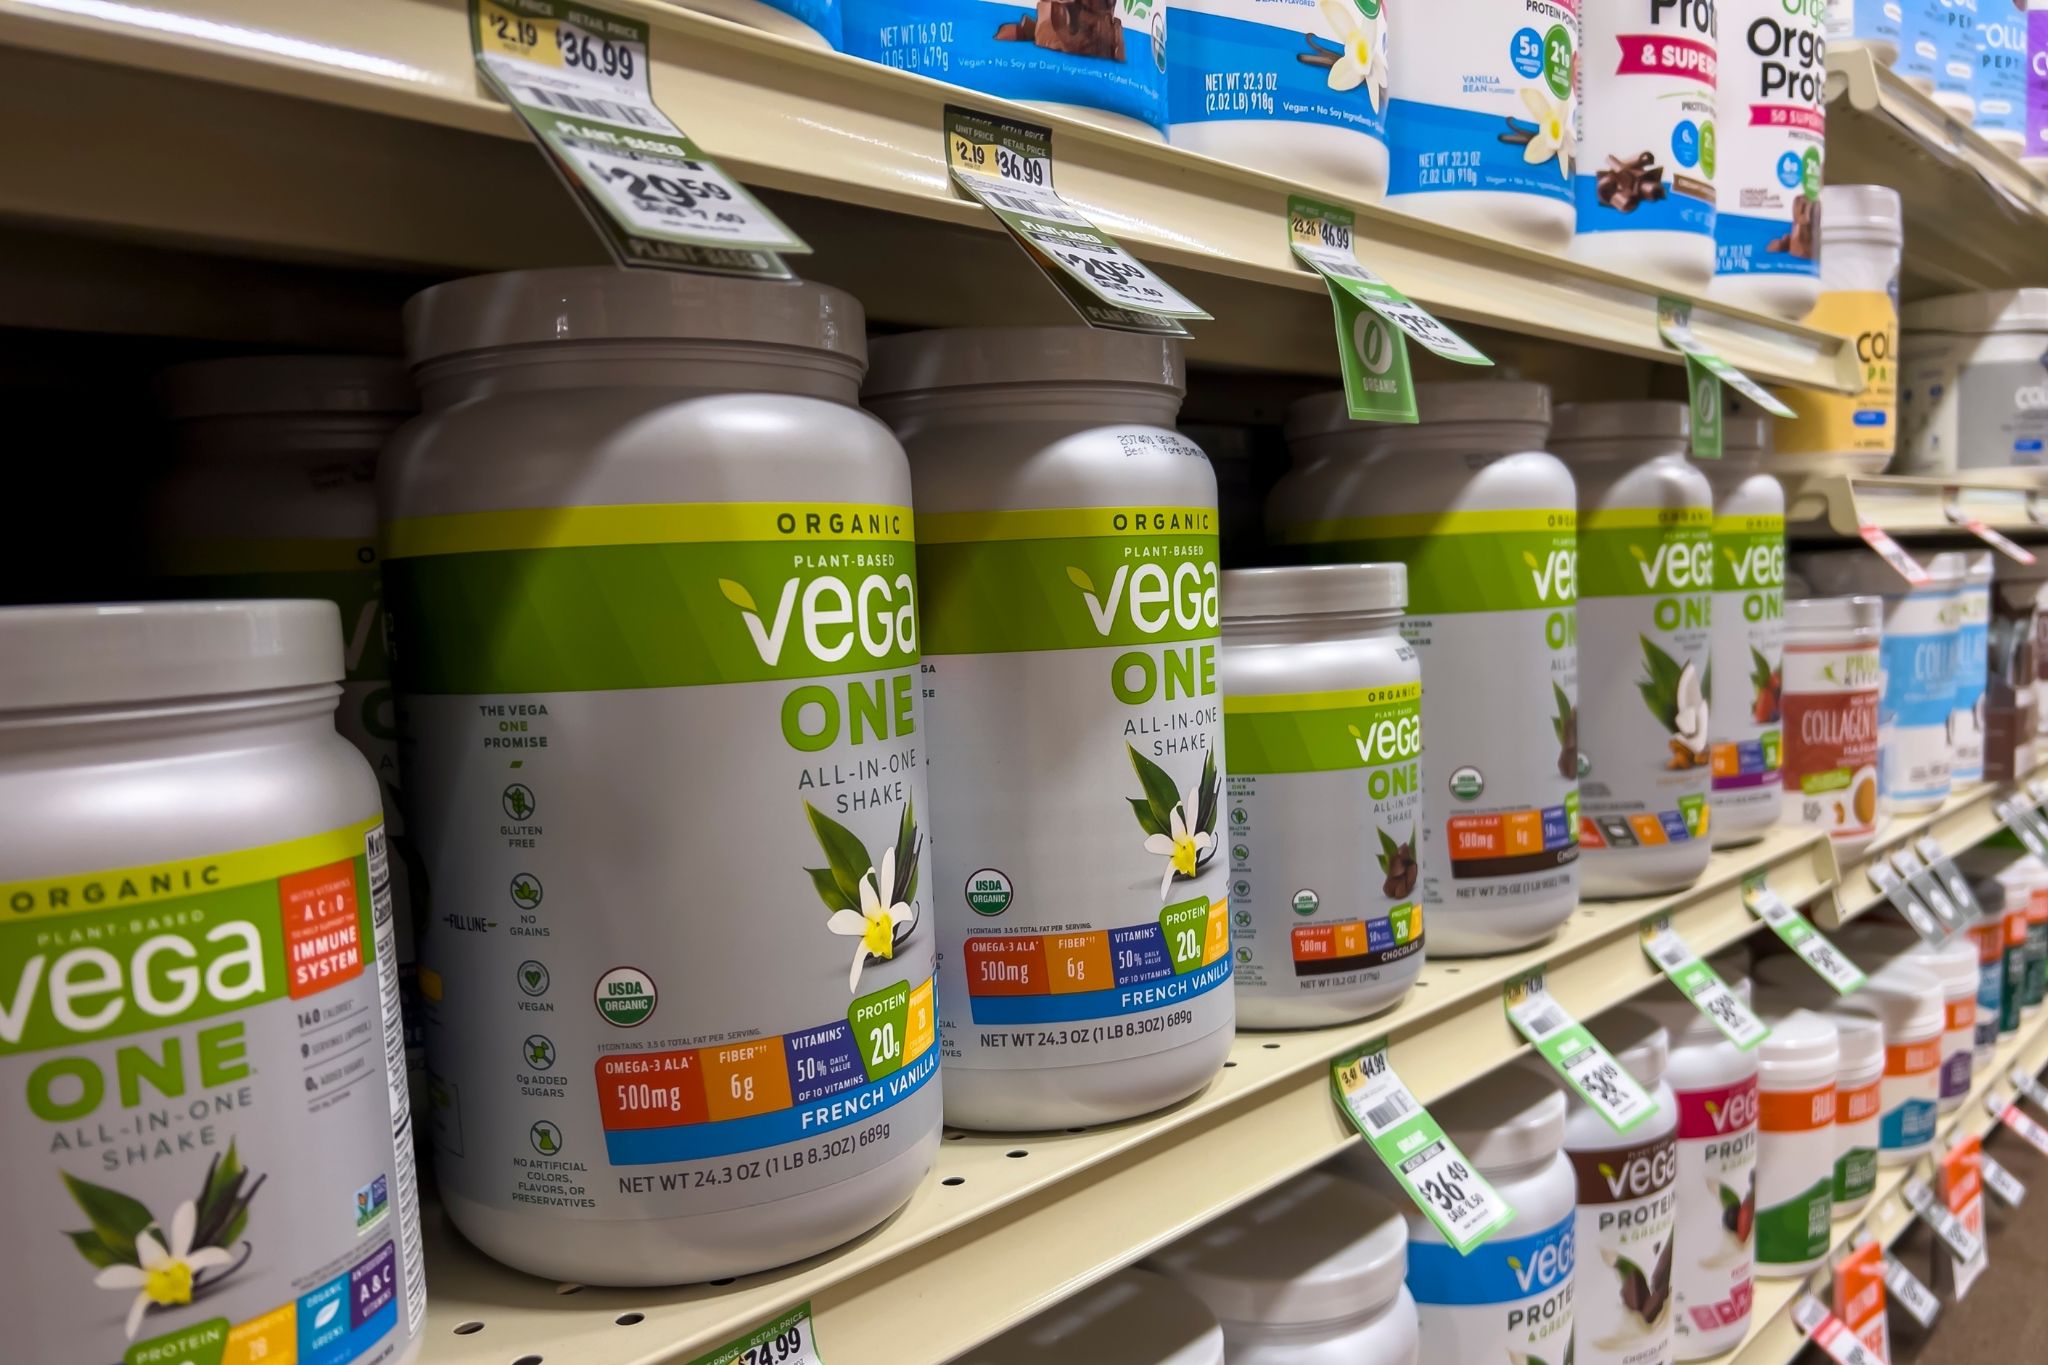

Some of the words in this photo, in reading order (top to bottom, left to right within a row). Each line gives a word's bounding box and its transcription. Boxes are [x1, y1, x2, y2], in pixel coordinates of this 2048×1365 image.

[1526, 1, 1561, 20] PROTEIN
[880, 26, 898, 48] NET
[901, 25, 919, 46] WT
[917, 23, 937, 44] 16.9
[939, 22, 955, 43] OZ
[1519, 35, 1539, 58] 5g
[556, 26, 634, 81] $36.99
[905, 47, 921, 71] LB)
[923, 46, 949, 72] 479g
[959, 57, 985, 69] Vegan
[1010, 57, 1026, 71] Soy
[1641, 44, 1657, 66] &
[1205, 74, 1223, 91] NET
[1225, 73, 1241, 90] WT
[1243, 72, 1263, 90] 32.3
[1266, 72, 1277, 91] OZ
[1463, 75, 1500, 84] VANILLA
[1463, 84, 1488, 93] BEAN
[1205, 92, 1231, 114] (2.02
[1233, 92, 1248, 114] LB)
[1251, 92, 1274, 114] 918g
[1283, 102, 1308, 114] Vegan
[555, 120, 686, 157] PLANT-BASED
[974, 129, 994, 143] PRICE
[1003, 138, 1025, 152] RETAIL
[1026, 144, 1046, 158] PRICE
[956, 141, 985, 165] $2.19
[995, 150, 1043, 187] $36.99
[1437, 152, 1450, 167] WT
[1020, 220, 1103, 244] PLANT-BASED
[777, 512, 901, 535] ORGANIC
[1112, 513, 1210, 532] ORGANIC
[794, 553, 895, 568] PLANT-BASED
[1124, 546, 1204, 558] PLANT-BASED
[1111, 644, 1217, 706] ONE
[1368, 687, 1416, 703] ORGANIC
[480, 705, 505, 716] THE
[510, 704, 548, 716] VEGA
[780, 673, 916, 753] ONE
[1123, 706, 1217, 736] ALL-IN-ONE
[499, 720, 528, 732] ONE
[484, 736, 548, 748] PROMISE
[1153, 733, 1206, 757] SHAKE
[798, 748, 916, 791] ALL-IN-ONE
[1368, 762, 1418, 801] ONE
[836, 781, 903, 814] SHAKE
[500, 825, 543, 836] GLUTEN
[508, 838, 536, 848] FREE
[10, 866, 220, 914] ORGANIC
[975, 879, 1002, 892] USDA
[37, 909, 205, 947] PLANT-BASED
[467, 916, 487, 933] LINE
[520, 914, 537, 924] NO
[509, 926, 550, 937] GRAINS
[293, 925, 357, 962] IMMUNE
[1177, 929, 1201, 963] 20g
[1381, 941, 1418, 961] CHOCOLATE
[296, 947, 358, 985] SYSTEM
[1067, 957, 1085, 980] 6g
[1118, 950, 1142, 969] 50%
[981, 960, 1029, 984] 500mg
[1140, 968, 1171, 982] VITAMINS
[608, 981, 643, 996] USDA
[1121, 980, 1188, 1008] FRENCH
[1192, 961, 1229, 990] VANILLA
[518, 1001, 554, 1012] VEGAN
[605, 999, 649, 1012] ORGANIC
[980, 1033, 1006, 1048] NET
[1010, 1032, 1034, 1047] WT
[1037, 1030, 1068, 1046] 24.3
[1070, 1029, 1090, 1044] OZ
[1093, 1026, 1104, 1045] (1
[1107, 1023, 1123, 1040] LB
[1167, 1009, 1193, 1028] 689g
[870, 1022, 901, 1067] 20g
[26, 1021, 251, 1123] ONE
[605, 1058, 661, 1075] OMEGA-3
[797, 1059, 827, 1083] 50%
[516, 1074, 530, 1086] 0g
[531, 1075, 568, 1086] ADDED
[730, 1072, 754, 1102] 6g
[798, 1091, 811, 1102] OF
[824, 1074, 864, 1096] VITAMINS
[521, 1087, 565, 1098] SUGARS
[617, 1083, 681, 1112] 500mg
[801, 1087, 886, 1130] FRENCH
[889, 1054, 935, 1096] VANILLA
[49, 1086, 254, 1154] ALL-IN-ONE
[102, 1125, 217, 1171] SHAKE
[619, 1176, 654, 1194] NET
[660, 1172, 690, 1191] WT
[695, 1167, 733, 1189] 24.3
[736, 1161, 761, 1181] OZ
[765, 1157, 779, 1178] (1
[783, 1151, 804, 1172] LB
[859, 1122, 891, 1148] 689g
[513, 1157, 528, 1168] NO
[529, 1158, 588, 1172] ARTIFICIAL
[518, 1181, 568, 1196] FLAVORS,
[568, 1186, 585, 1196] OR
[527, 1171, 573, 1184] COLORS,
[512, 1192, 596, 1208] PRESERVATIVES
[750, 1326, 779, 1346] RETAIL
[780, 1311, 804, 1330] PRICE
[136, 1328, 220, 1365] PROTEIN
